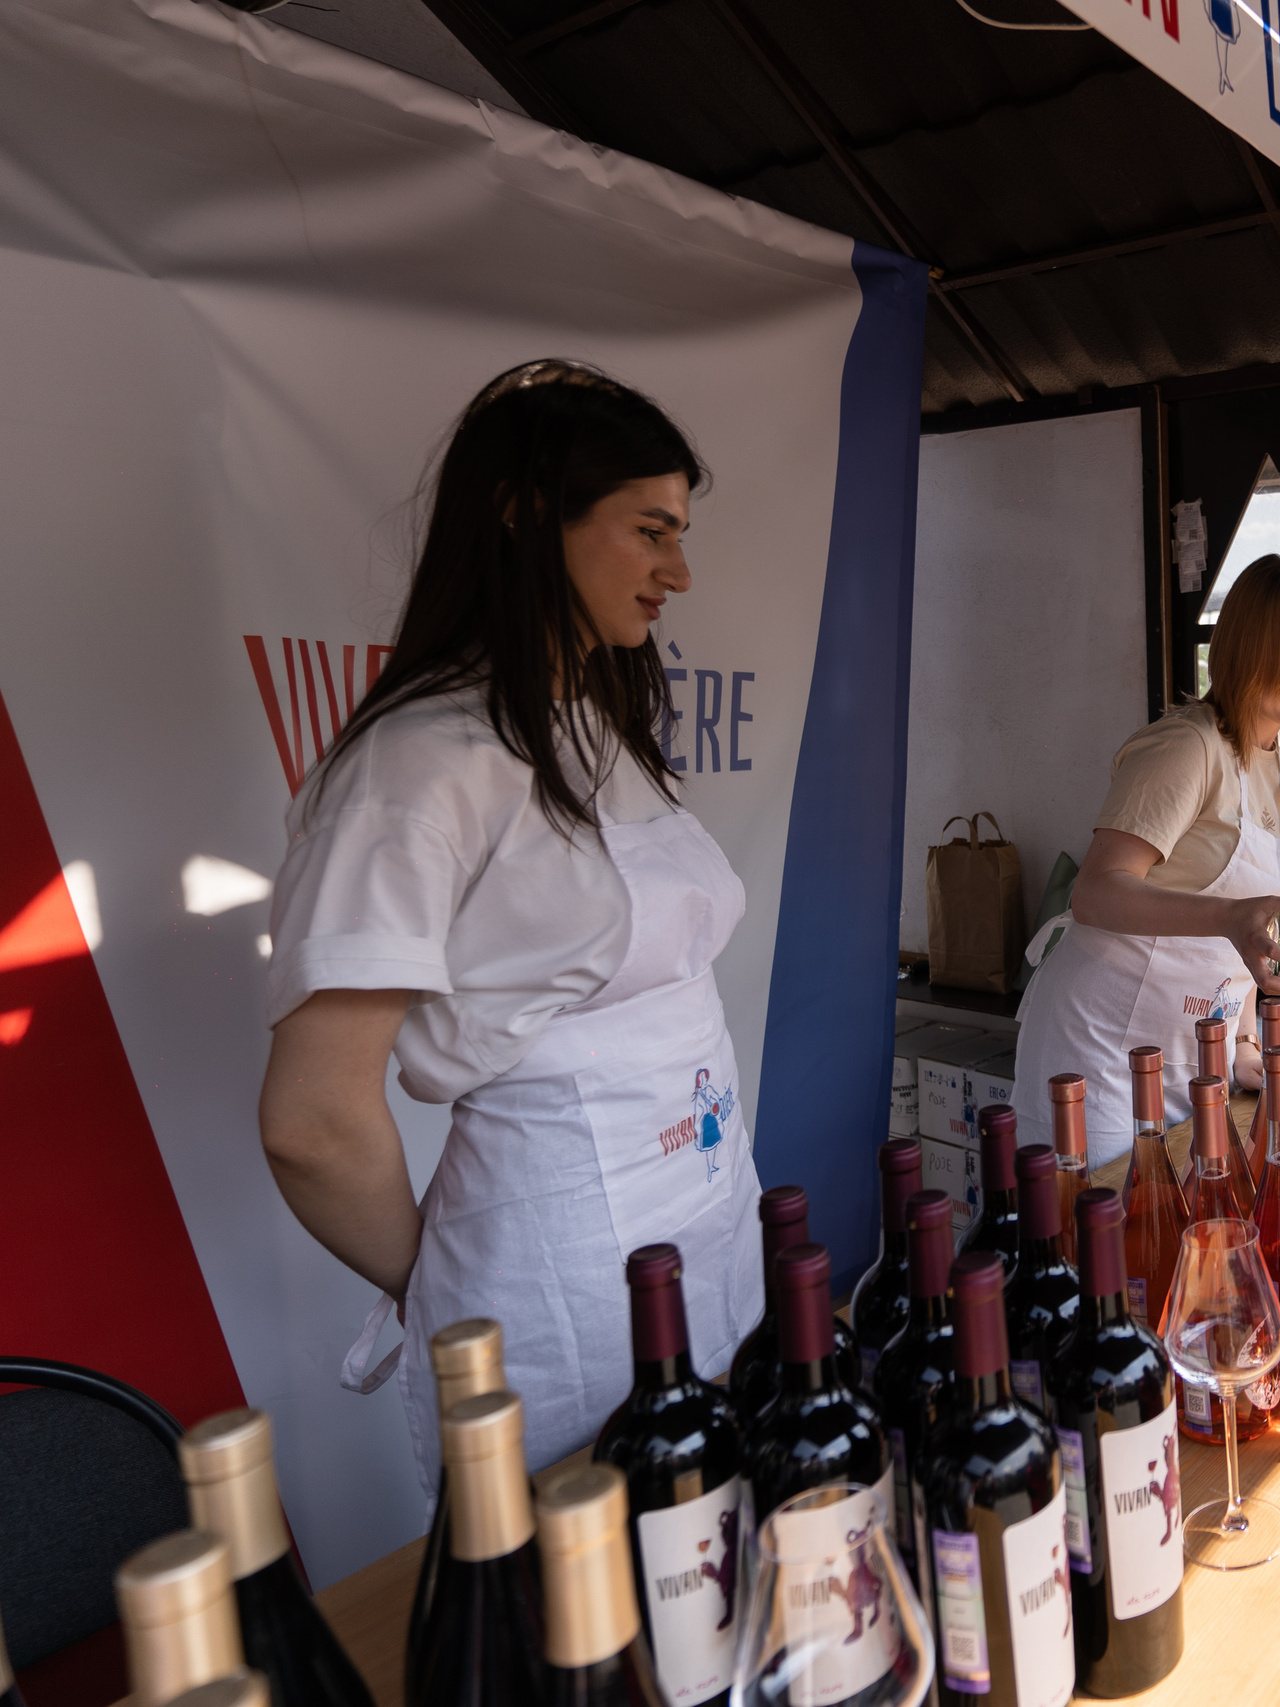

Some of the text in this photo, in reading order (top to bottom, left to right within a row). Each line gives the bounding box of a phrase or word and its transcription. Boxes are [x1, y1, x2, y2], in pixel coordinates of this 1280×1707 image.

[1183, 995, 1213, 1018] VIVAN
[660, 1114, 696, 1156] VIVAN
[950, 1119, 969, 1137] VIVAN
[953, 1199, 972, 1217] VIVAN
[1114, 1484, 1151, 1516] VIVAN
[656, 1568, 703, 1601] VIVAN
[1019, 1574, 1055, 1617] VIVAN
